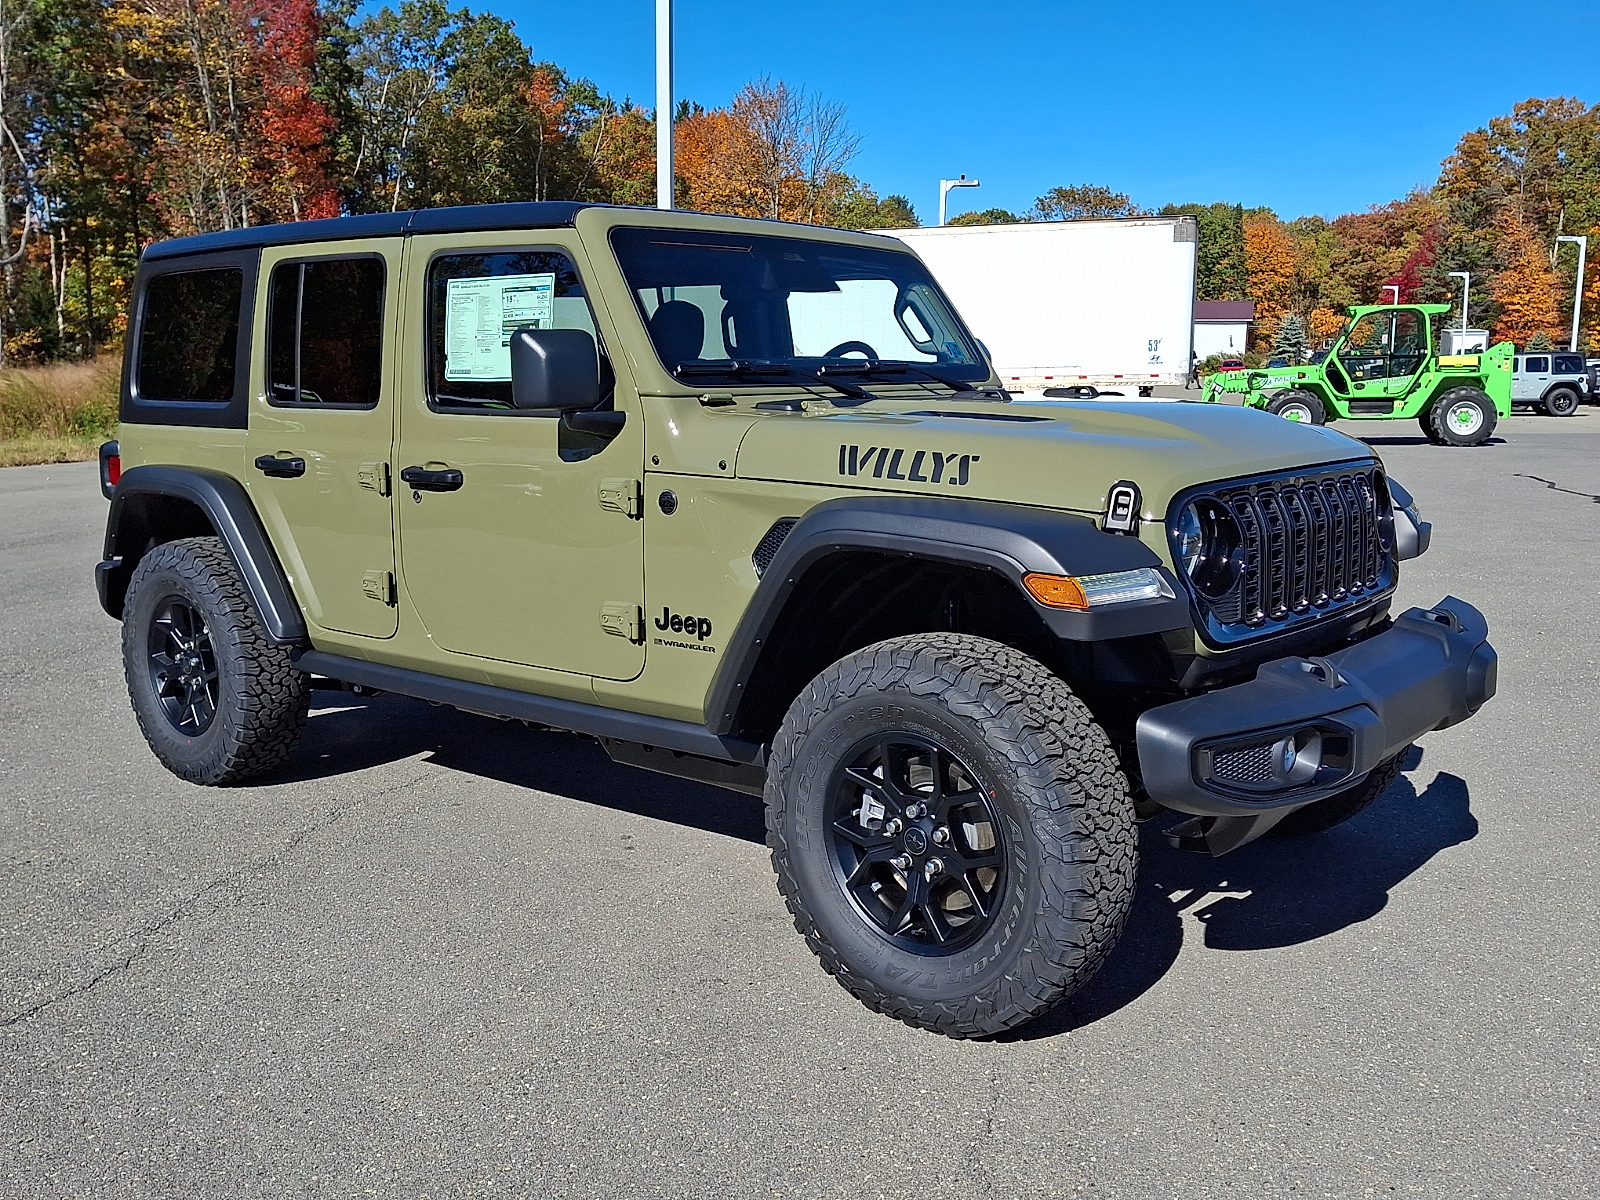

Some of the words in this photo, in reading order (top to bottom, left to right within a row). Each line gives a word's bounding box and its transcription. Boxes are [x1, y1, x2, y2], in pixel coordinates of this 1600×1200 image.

[839, 444, 981, 486] WILLYS
[654, 606, 713, 641] Jeep
[663, 639, 716, 653] WRANGLER
